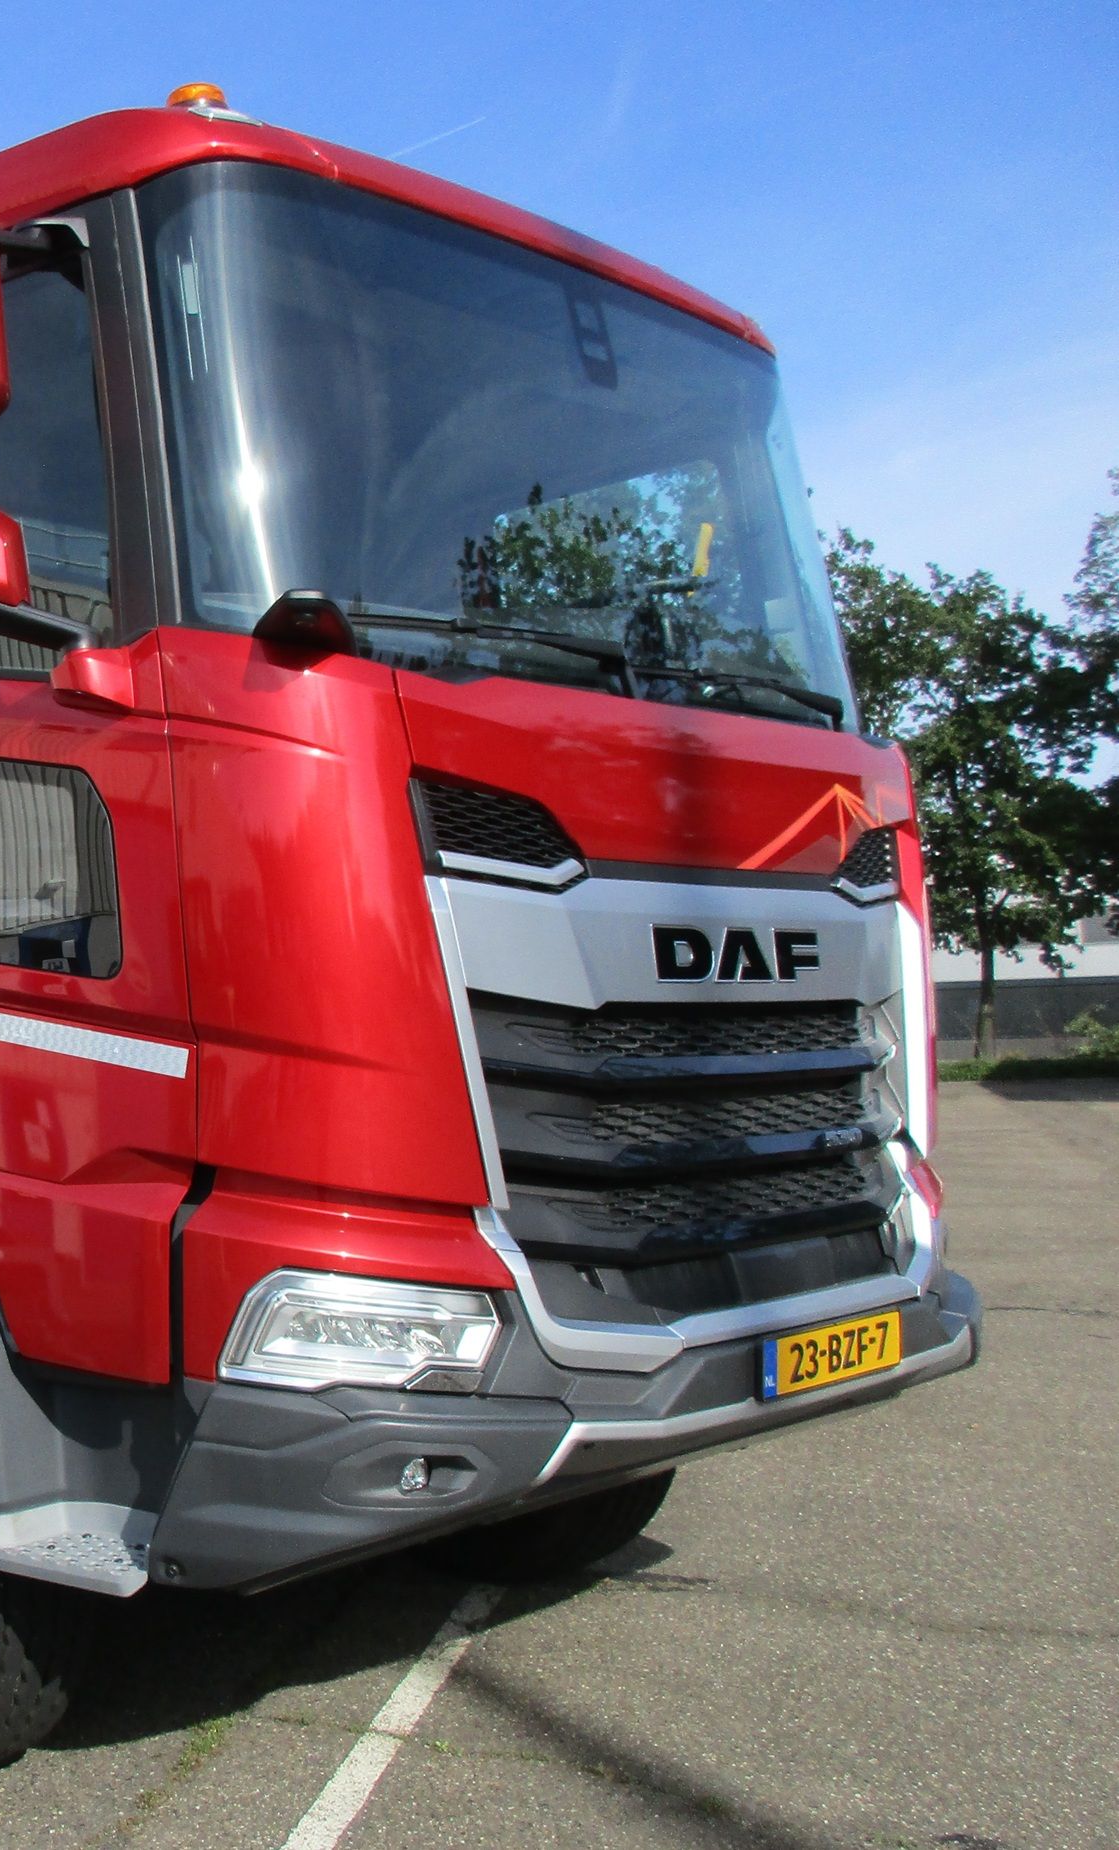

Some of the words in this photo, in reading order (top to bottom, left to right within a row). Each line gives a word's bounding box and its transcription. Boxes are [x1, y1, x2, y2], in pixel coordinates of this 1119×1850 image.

[650, 923, 820, 983] DAF
[764, 1375, 776, 1387] NL
[790, 1321, 889, 1384] 23-BZF-7
